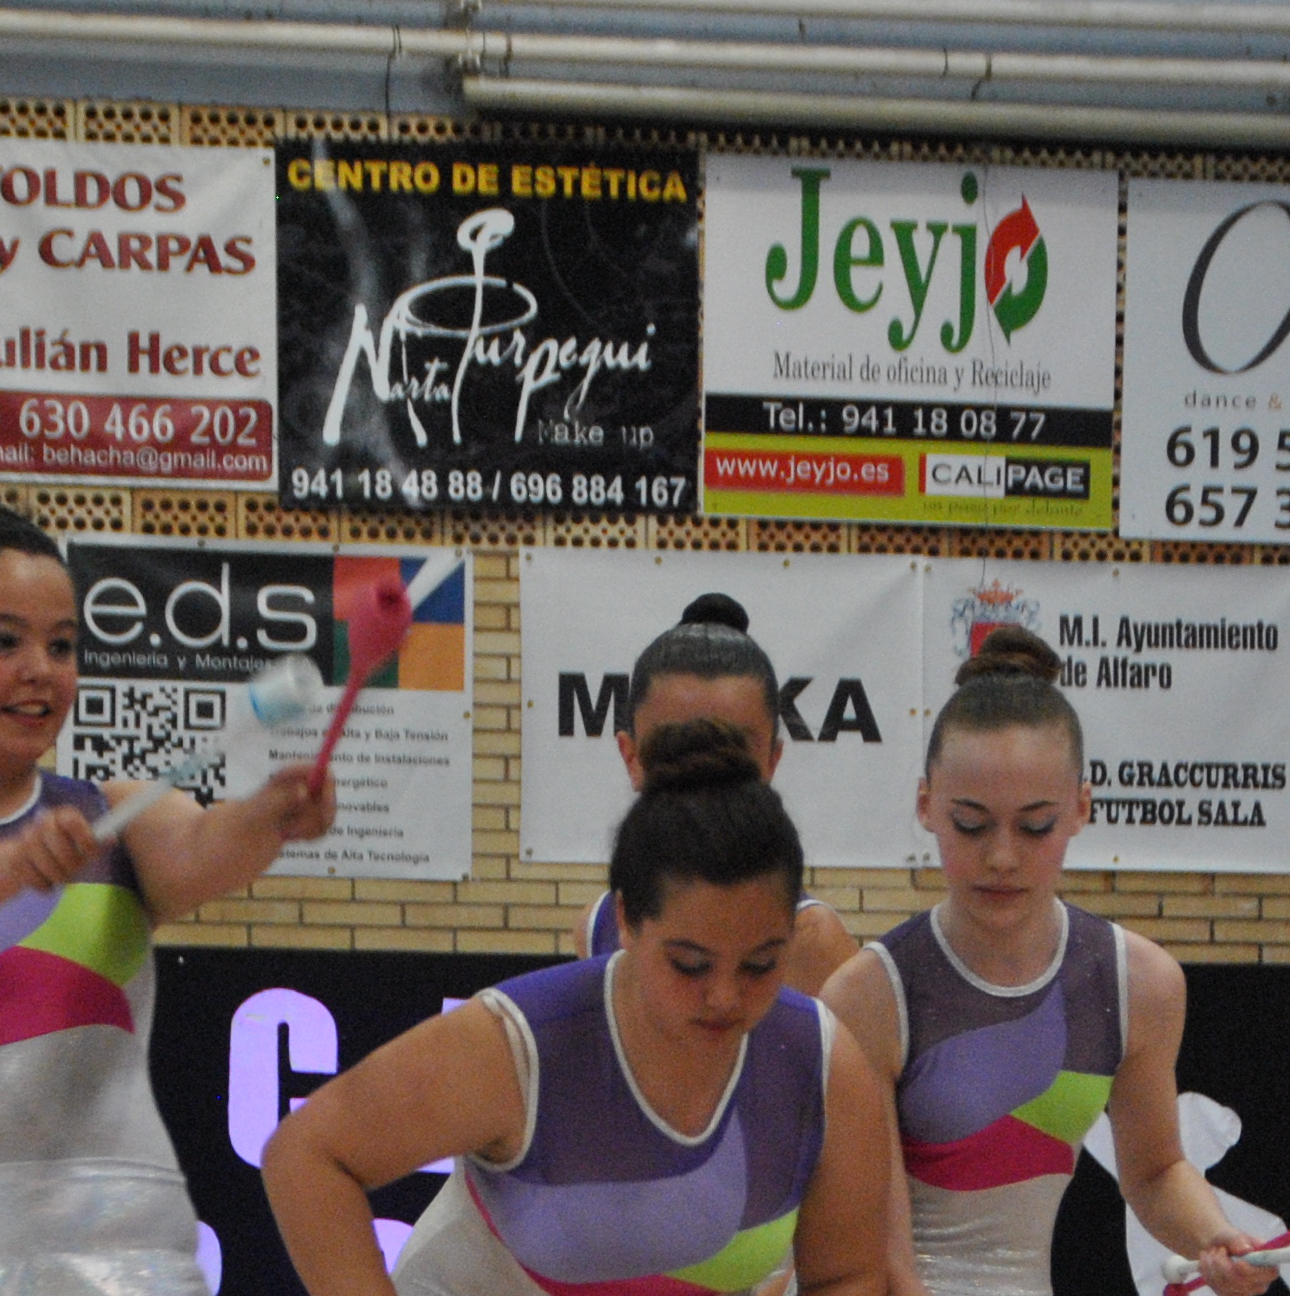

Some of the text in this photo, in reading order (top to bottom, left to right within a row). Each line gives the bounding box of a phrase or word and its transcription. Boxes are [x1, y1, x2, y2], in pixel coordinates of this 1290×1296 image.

[288, 158, 687, 202] CENTRO DE ESTÉTICA
[38, 228, 256, 275] CARPAS
[765, 165, 1048, 354] Jeyjo
[127, 330, 261, 378] Herce
[773, 352, 1051, 394] Material de oficina y Reciclaje
[1183, 390, 1257, 409] dance
[1267, 393, 1282, 410] &
[19, 399, 257, 445] 630 466 202
[763, 401, 1045, 440] Tel.: 941 18 08 77
[43, 444, 268, 474] behacha@gmail.com
[1166, 425, 1259, 469] 619
[292, 467, 686, 507] 941 18 48 88 / 696 884 167
[716, 456, 889, 485] www.jeyjo.es
[1165, 483, 1258, 527] 657
[83, 562, 316, 651] e.d.s
[1059, 614, 1279, 653] M.I. Ayuntamiento
[177, 655, 187, 669] y
[1059, 656, 1172, 689] de Alfaro
[1118, 761, 1286, 789] GRACCURRIS
[1089, 798, 1266, 827] FUTBOL SALA
